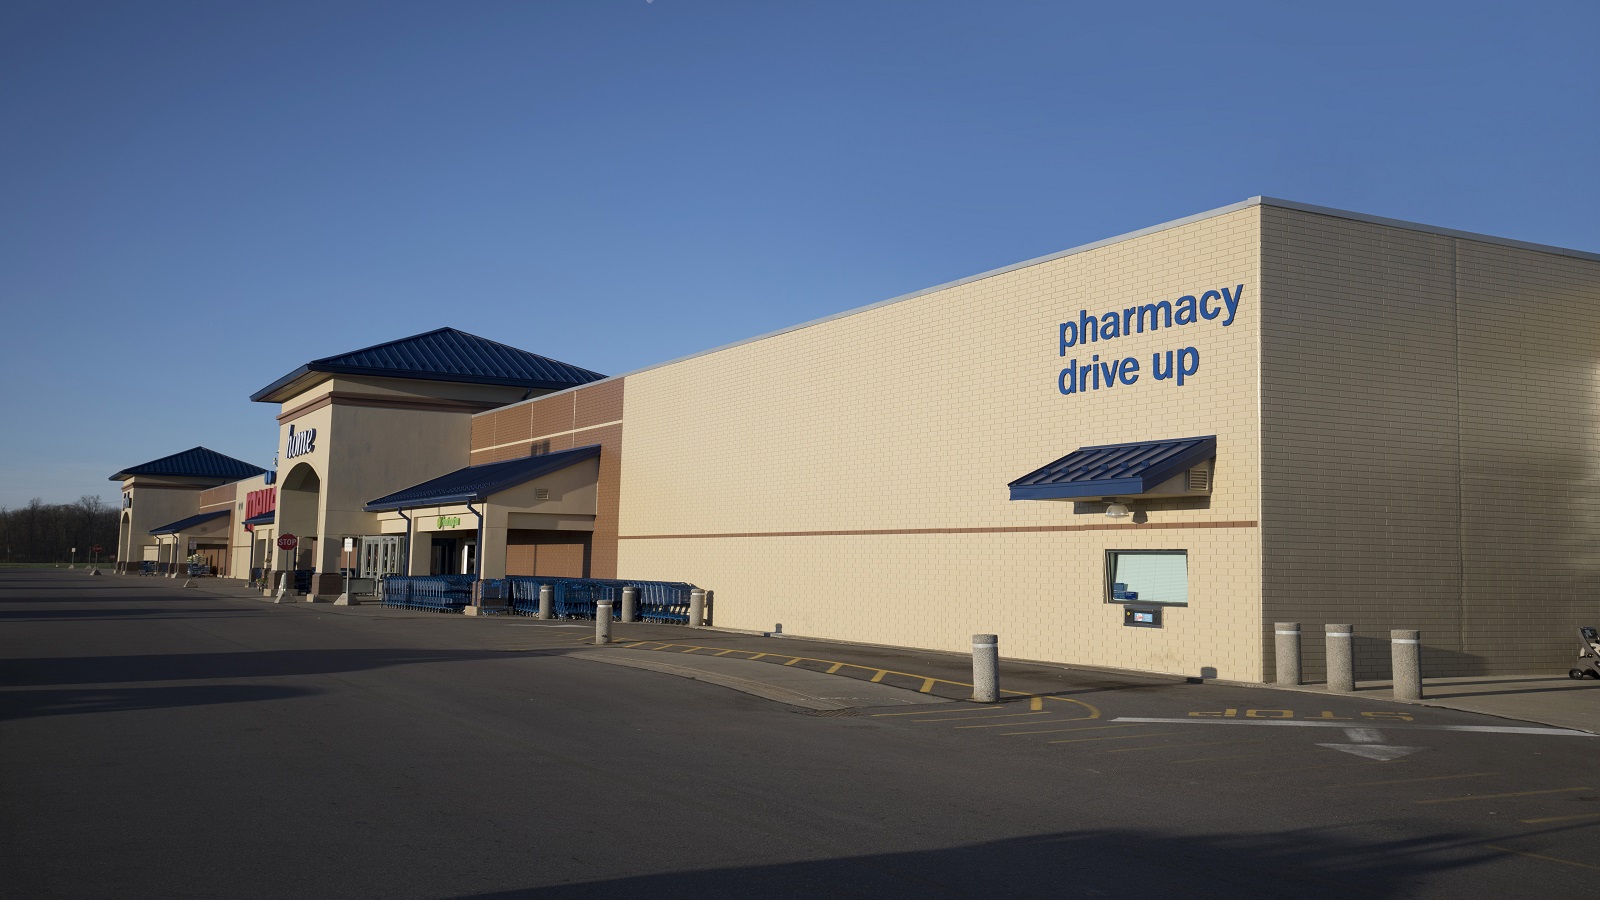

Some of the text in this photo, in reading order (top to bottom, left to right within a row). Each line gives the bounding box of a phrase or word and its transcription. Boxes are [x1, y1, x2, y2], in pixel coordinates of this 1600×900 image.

[1059, 283, 1244, 357] pharmacy
[1058, 346, 1200, 395] drive up
[286, 424, 316, 459] home
[278, 538, 297, 546] STOP
[1188, 708, 1414, 721] STOP
